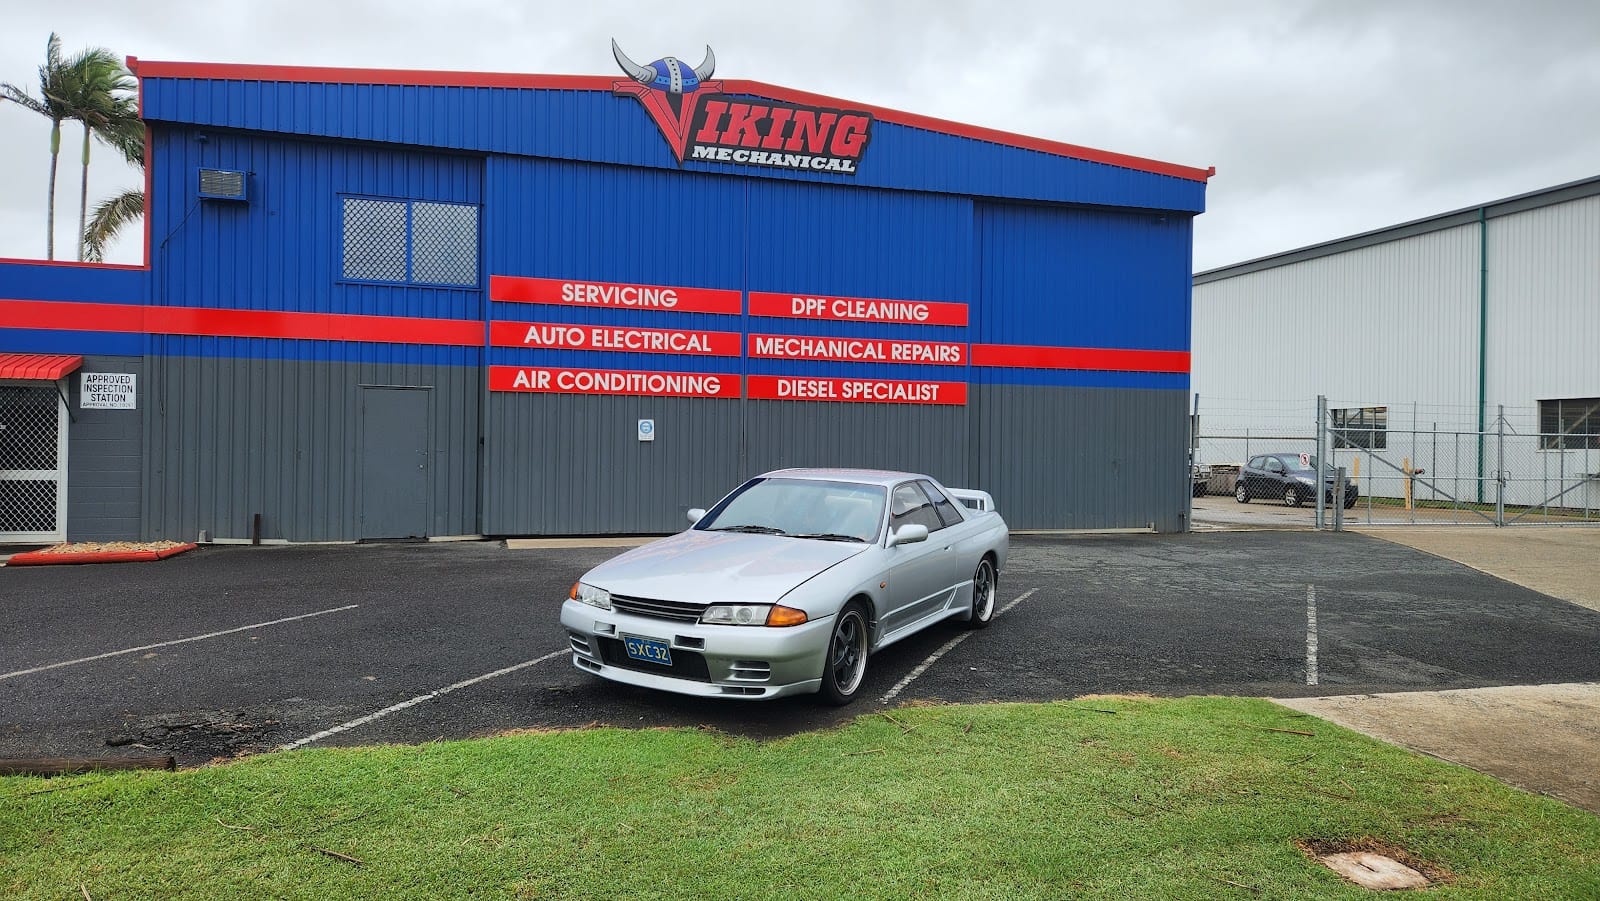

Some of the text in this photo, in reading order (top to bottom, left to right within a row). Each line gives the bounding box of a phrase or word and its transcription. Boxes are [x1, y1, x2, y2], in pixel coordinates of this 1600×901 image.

[612, 80, 870, 165] VIKING
[691, 145, 857, 172] MECHANICAL
[561, 283, 679, 308] SERVICING
[791, 297, 929, 321] DPF CLEANING
[523, 325, 712, 352] AUTO ELECTRICAL
[756, 337, 961, 363] MECHANICAL REPAIRS
[83, 384, 133, 393] INSPECTION
[86, 374, 131, 383] APPROVED
[512, 369, 721, 395] AIR CONDITIONING
[777, 379, 940, 401] DIESEL SPECIALIST
[90, 393, 126, 402] STATION
[628, 642, 669, 660] SXC32
